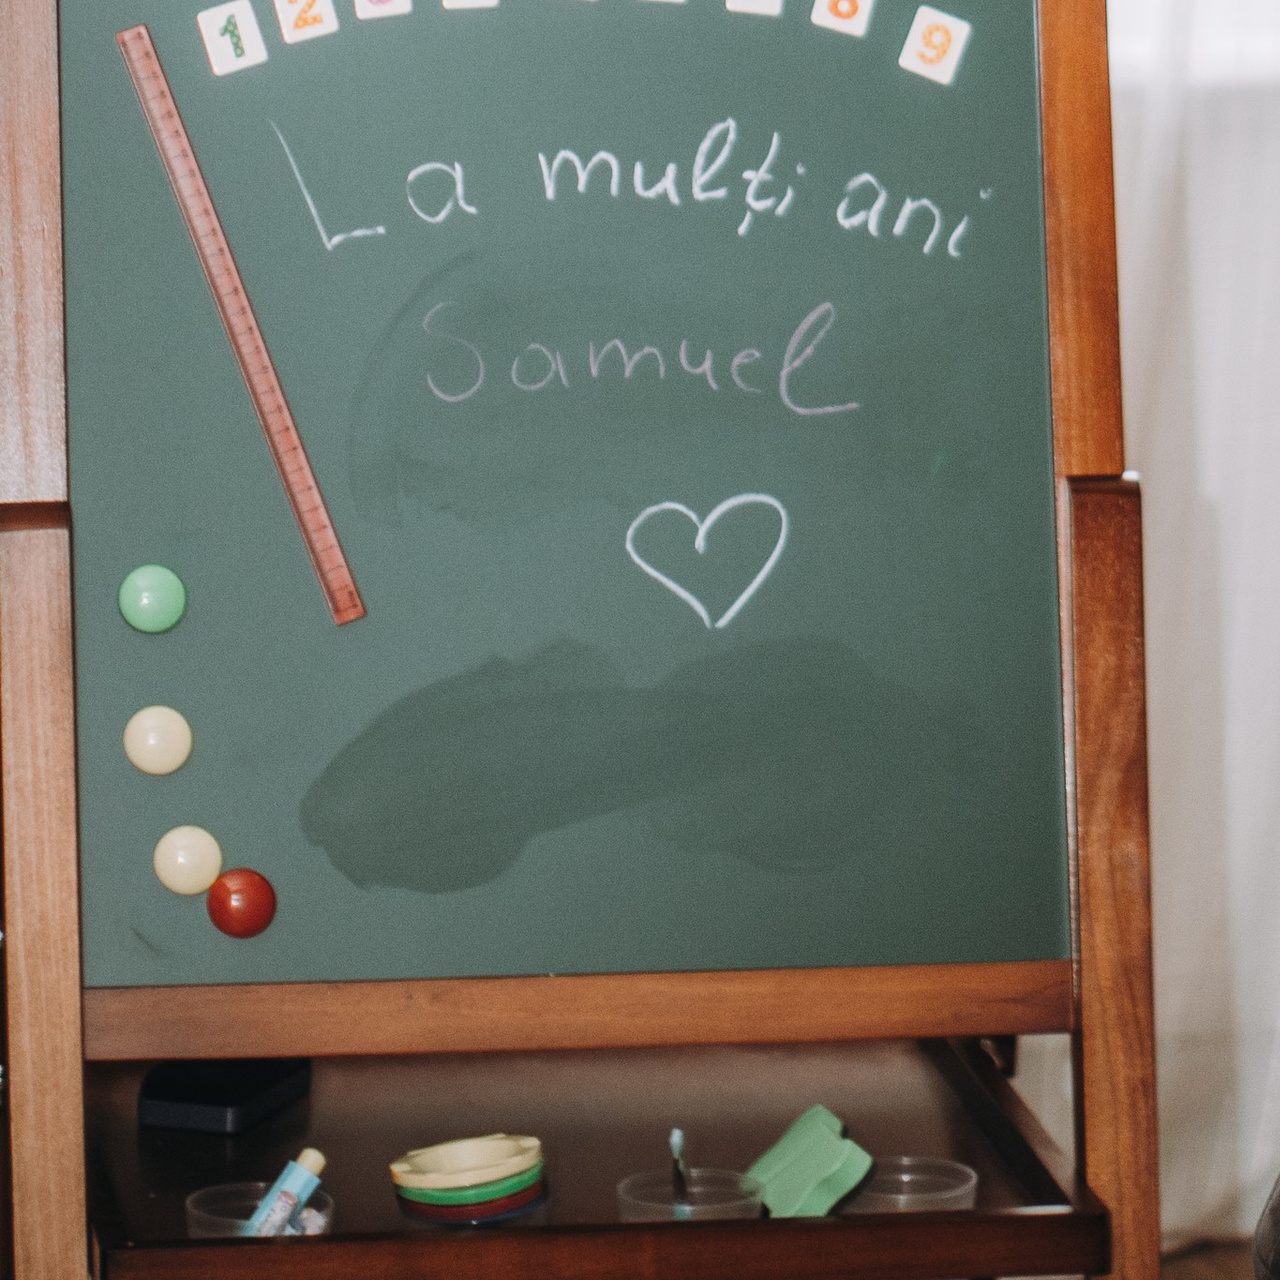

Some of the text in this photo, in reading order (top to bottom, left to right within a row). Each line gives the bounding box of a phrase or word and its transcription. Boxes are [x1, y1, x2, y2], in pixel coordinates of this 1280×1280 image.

[219, 14, 246, 59] 1
[916, 23, 952, 66] 9
[268, 119, 478, 251] La
[836, 172, 994, 258] ani
[420, 301, 861, 416] Samuel
